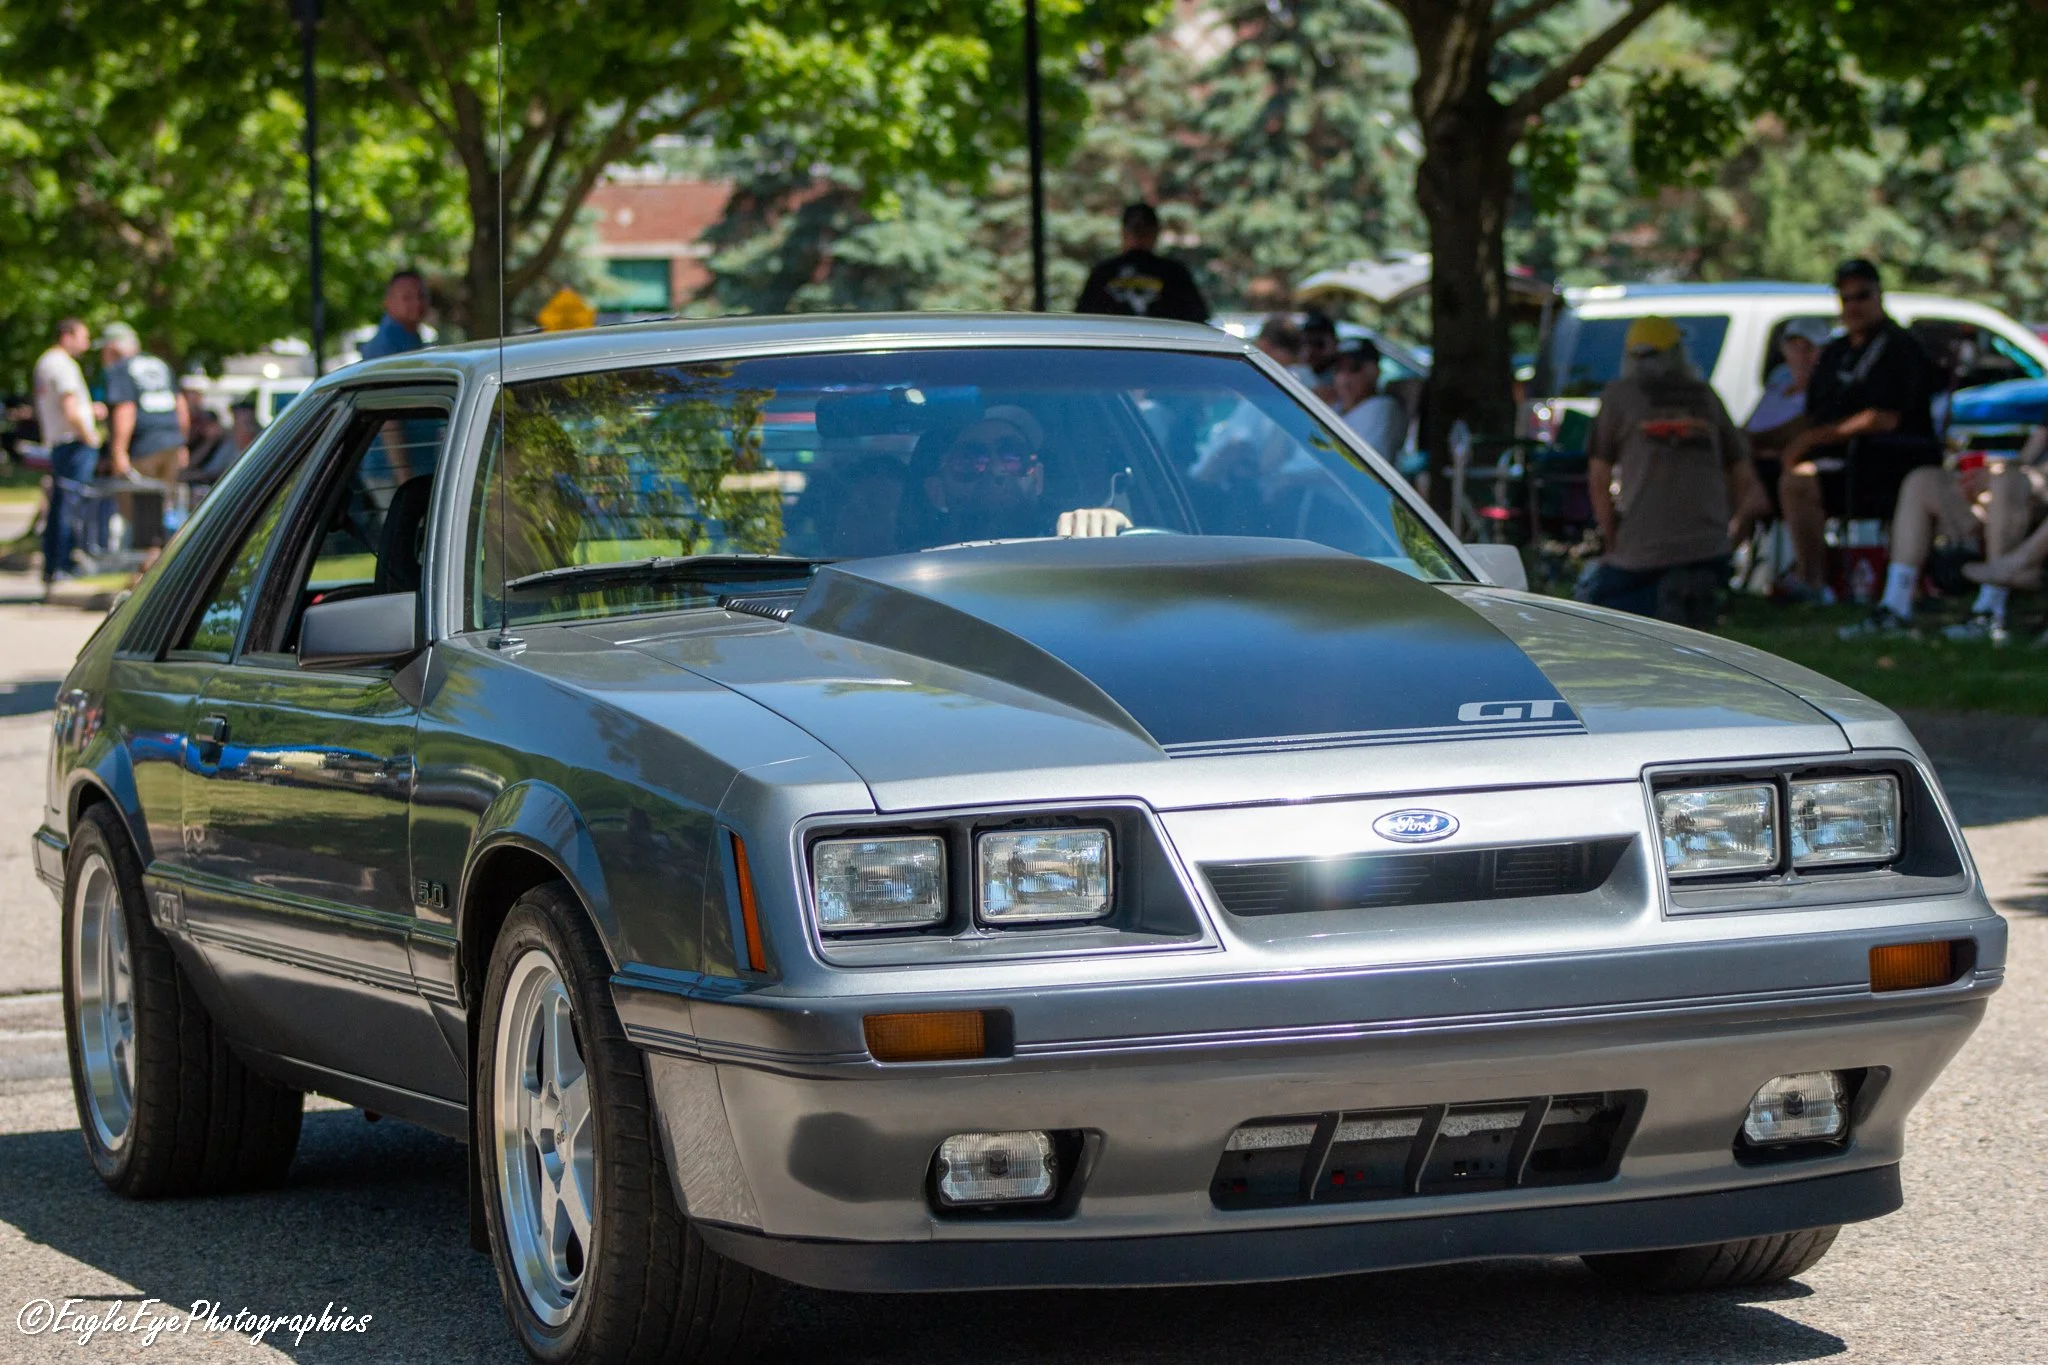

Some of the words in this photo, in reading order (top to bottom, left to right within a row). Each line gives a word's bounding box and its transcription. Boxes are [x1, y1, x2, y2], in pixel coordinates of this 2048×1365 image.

[1458, 700, 1567, 721] GT
[1395, 814, 1439, 833] Ford
[417, 880, 445, 909] 5.0
